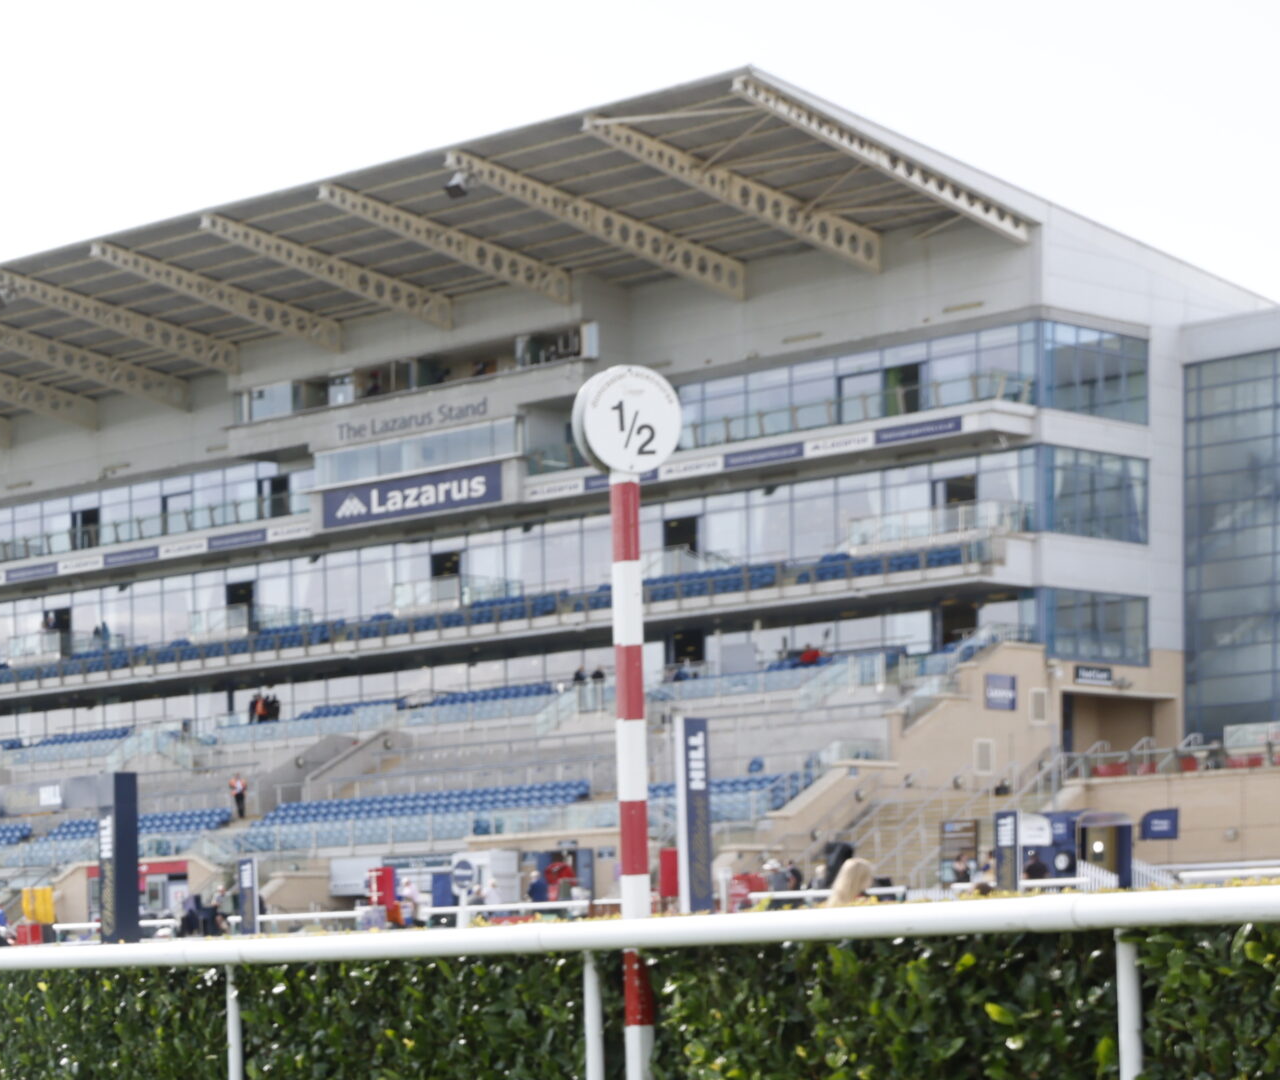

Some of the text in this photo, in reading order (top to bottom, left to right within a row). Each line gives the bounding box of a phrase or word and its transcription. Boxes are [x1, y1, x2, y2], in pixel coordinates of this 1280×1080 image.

[337, 397, 488, 440] The Lazarus Stand
[370, 475, 487, 514] Lazarus
[688, 731, 707, 790] HILL
[100, 815, 113, 859] HILL
